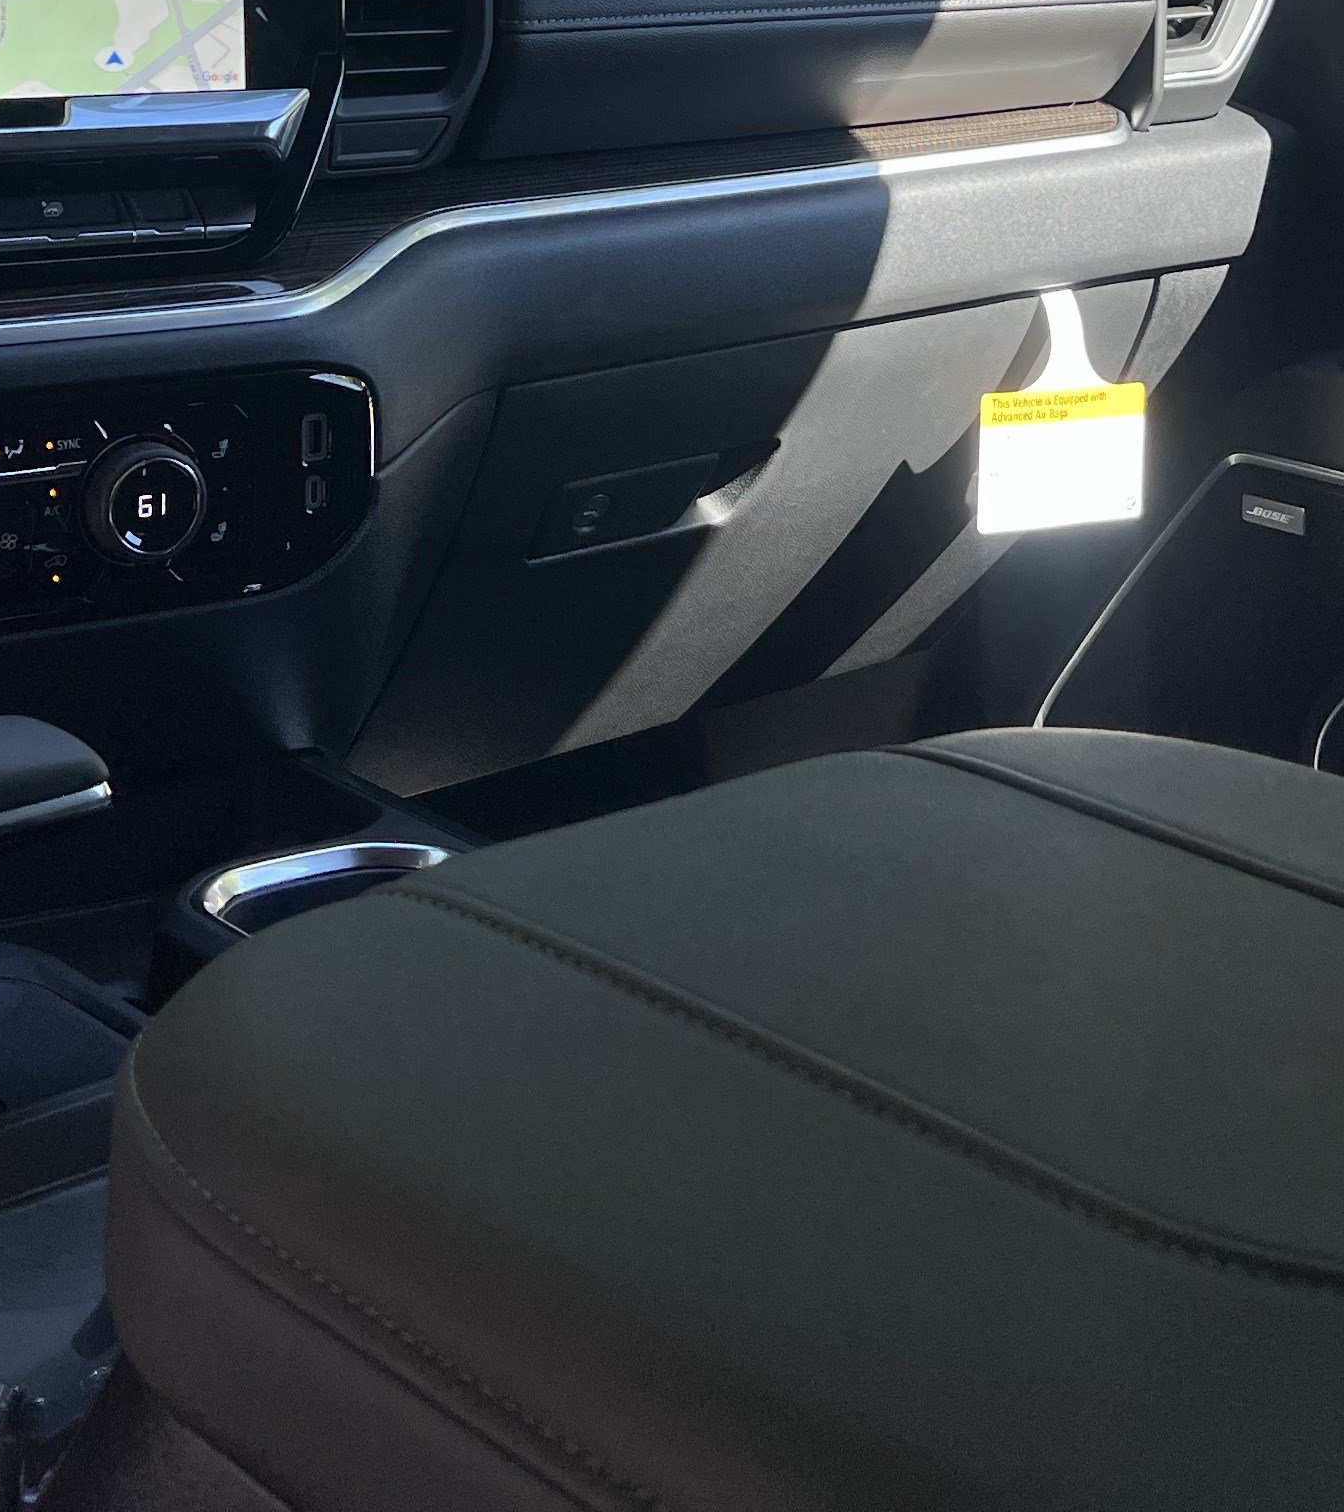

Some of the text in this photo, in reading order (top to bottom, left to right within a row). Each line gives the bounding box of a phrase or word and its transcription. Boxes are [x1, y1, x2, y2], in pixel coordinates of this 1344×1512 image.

[202, 71, 239, 84] Google
[992, 397, 1011, 409] This
[1013, 396, 1043, 408] Vehicle
[1053, 392, 1089, 406] Equipped
[1090, 391, 1107, 401] with
[991, 410, 1034, 422] Advanced
[1049, 408, 1069, 420] Bags
[56, 437, 81, 451] SYNC
[138, 493, 167, 519] 61
[1246, 506, 1294, 525] BOSE
